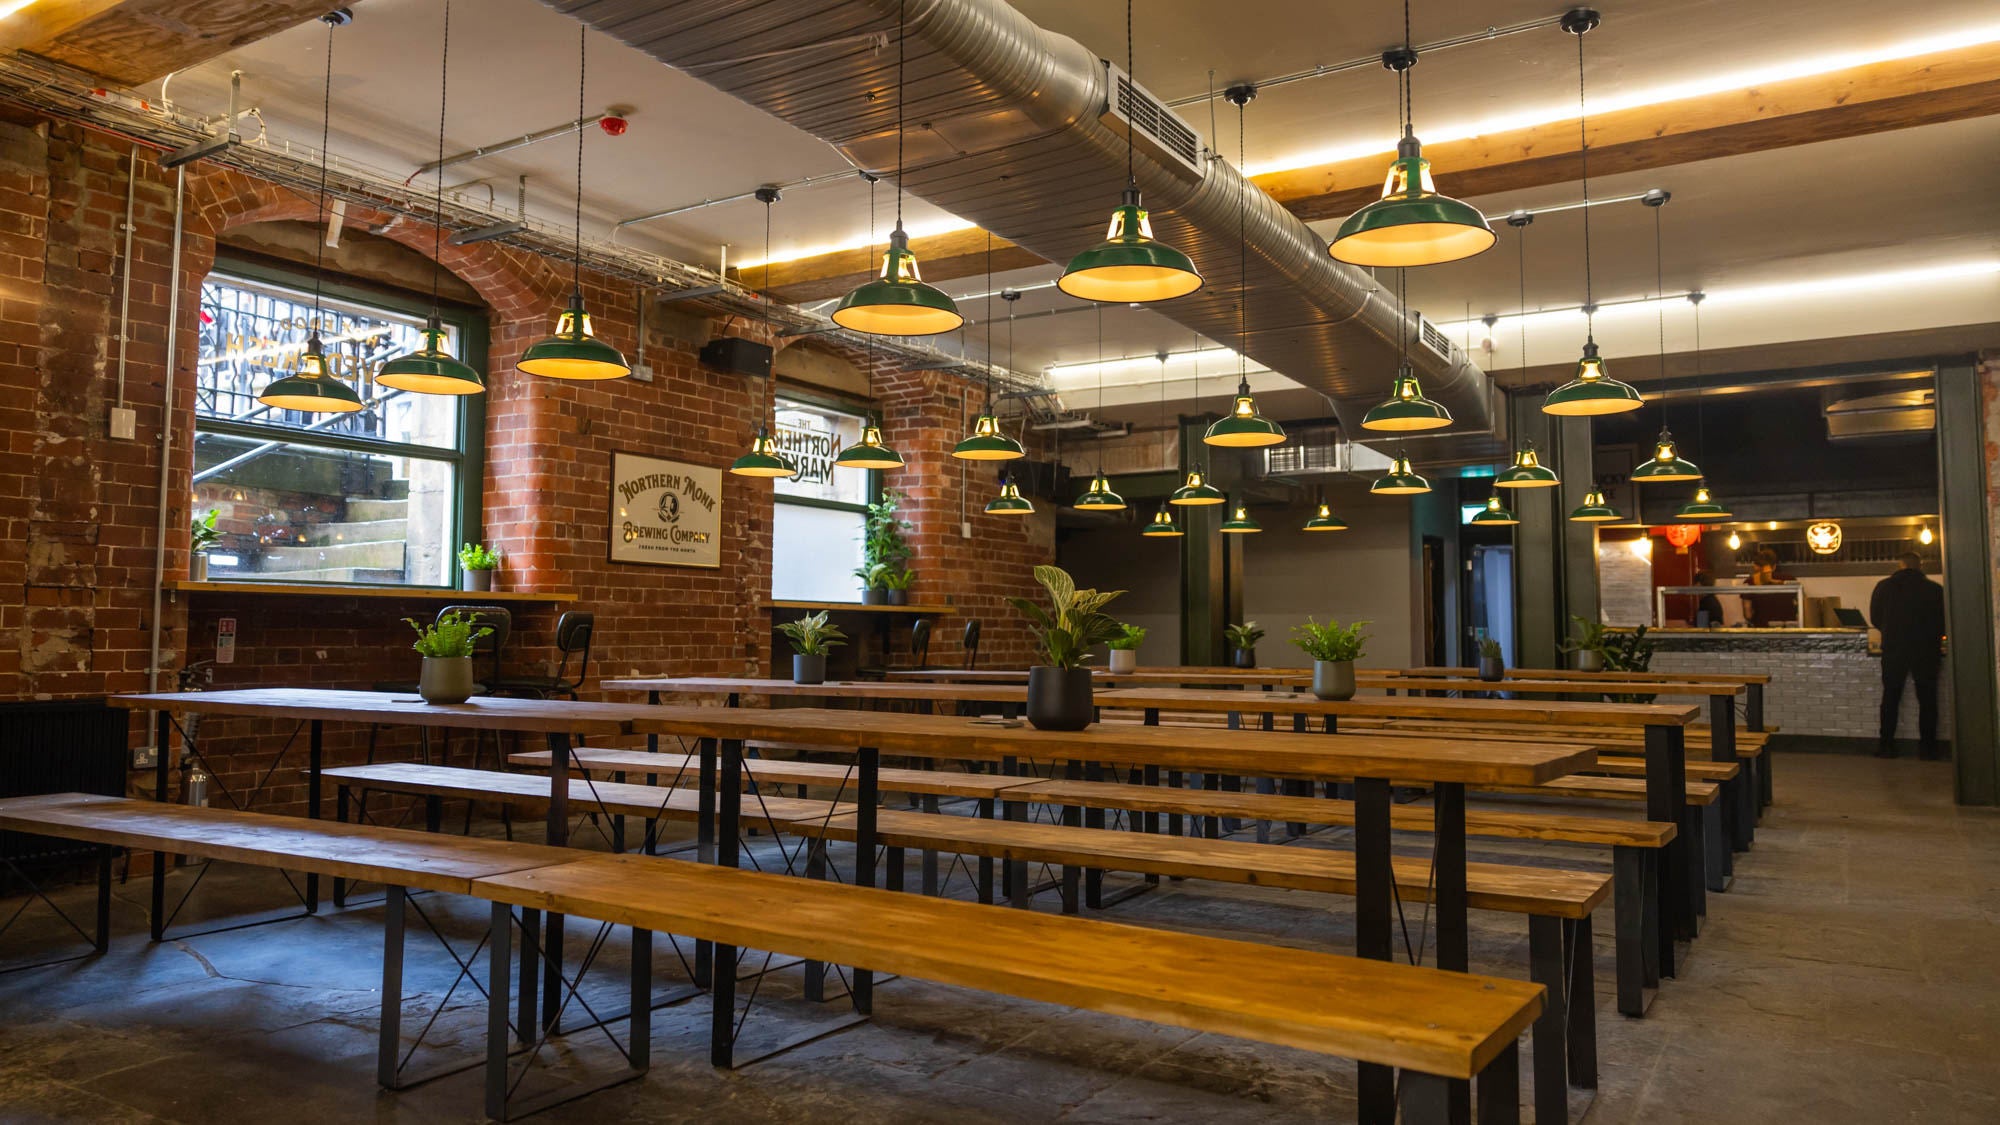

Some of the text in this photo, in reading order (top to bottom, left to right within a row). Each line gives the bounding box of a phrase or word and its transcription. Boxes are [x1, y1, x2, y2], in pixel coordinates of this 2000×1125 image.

[618, 474, 716, 512] NORTHERN MONK
[623, 521, 711, 545] BREWING COMPANY
